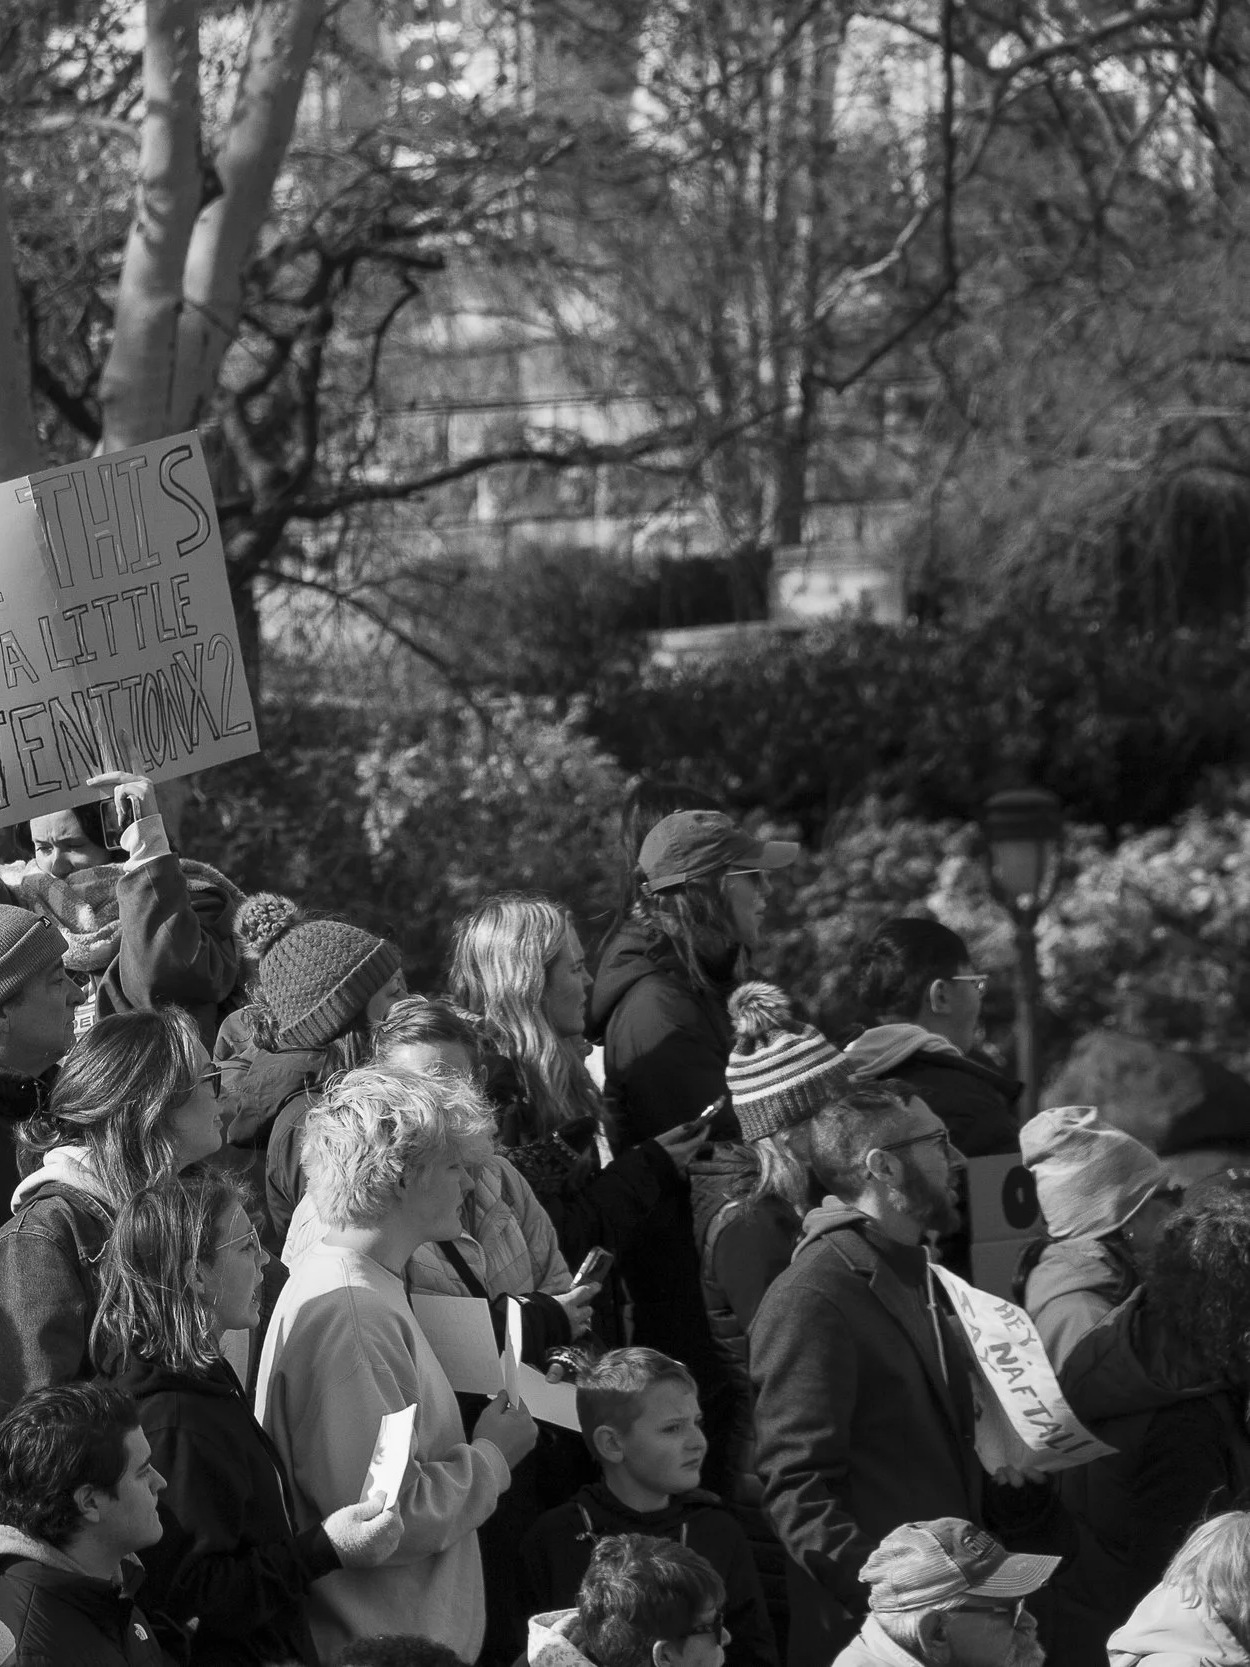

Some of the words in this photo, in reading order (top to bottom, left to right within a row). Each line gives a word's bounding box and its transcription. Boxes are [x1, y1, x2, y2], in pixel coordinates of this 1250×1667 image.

[15, 444, 211, 589] THIS
[38, 573, 198, 672] LITTLE
[989, 1342, 1096, 1454] NAFTALI
